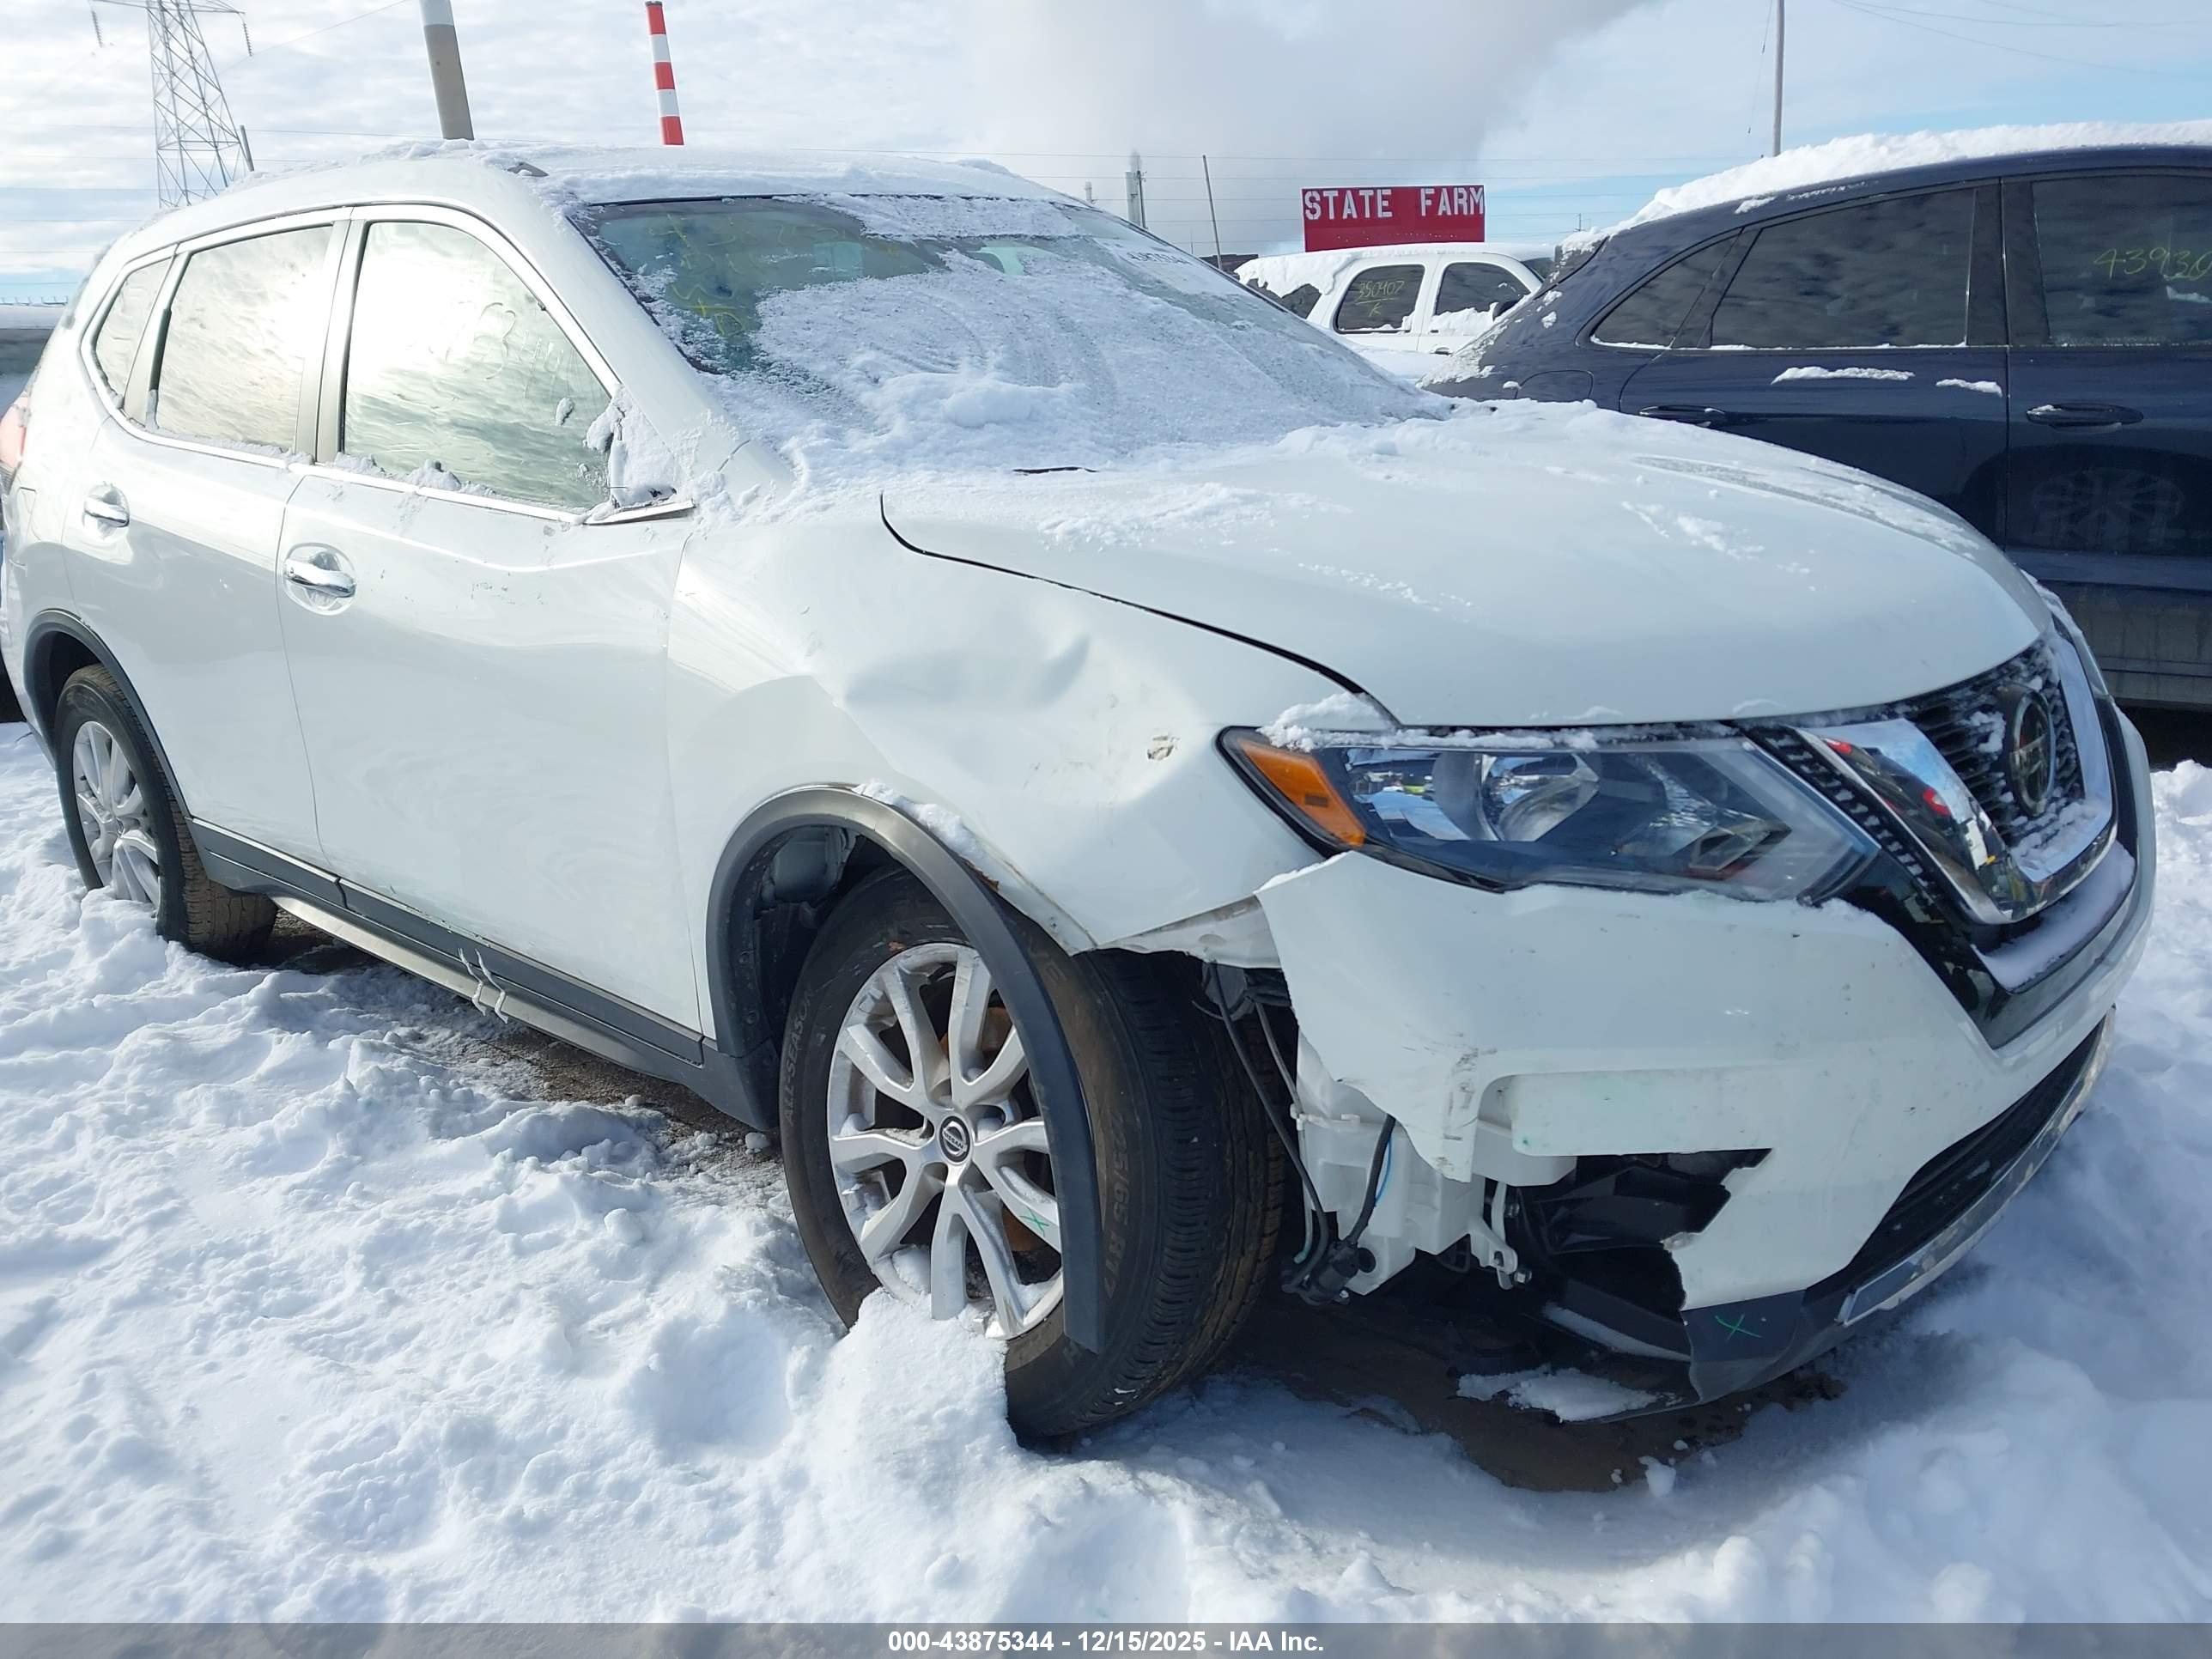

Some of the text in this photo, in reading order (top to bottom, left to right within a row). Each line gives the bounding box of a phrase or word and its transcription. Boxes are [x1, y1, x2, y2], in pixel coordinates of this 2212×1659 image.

[1304, 185, 1484, 221] STATE FARM
[942, 1130, 965, 1152] NISSAN
